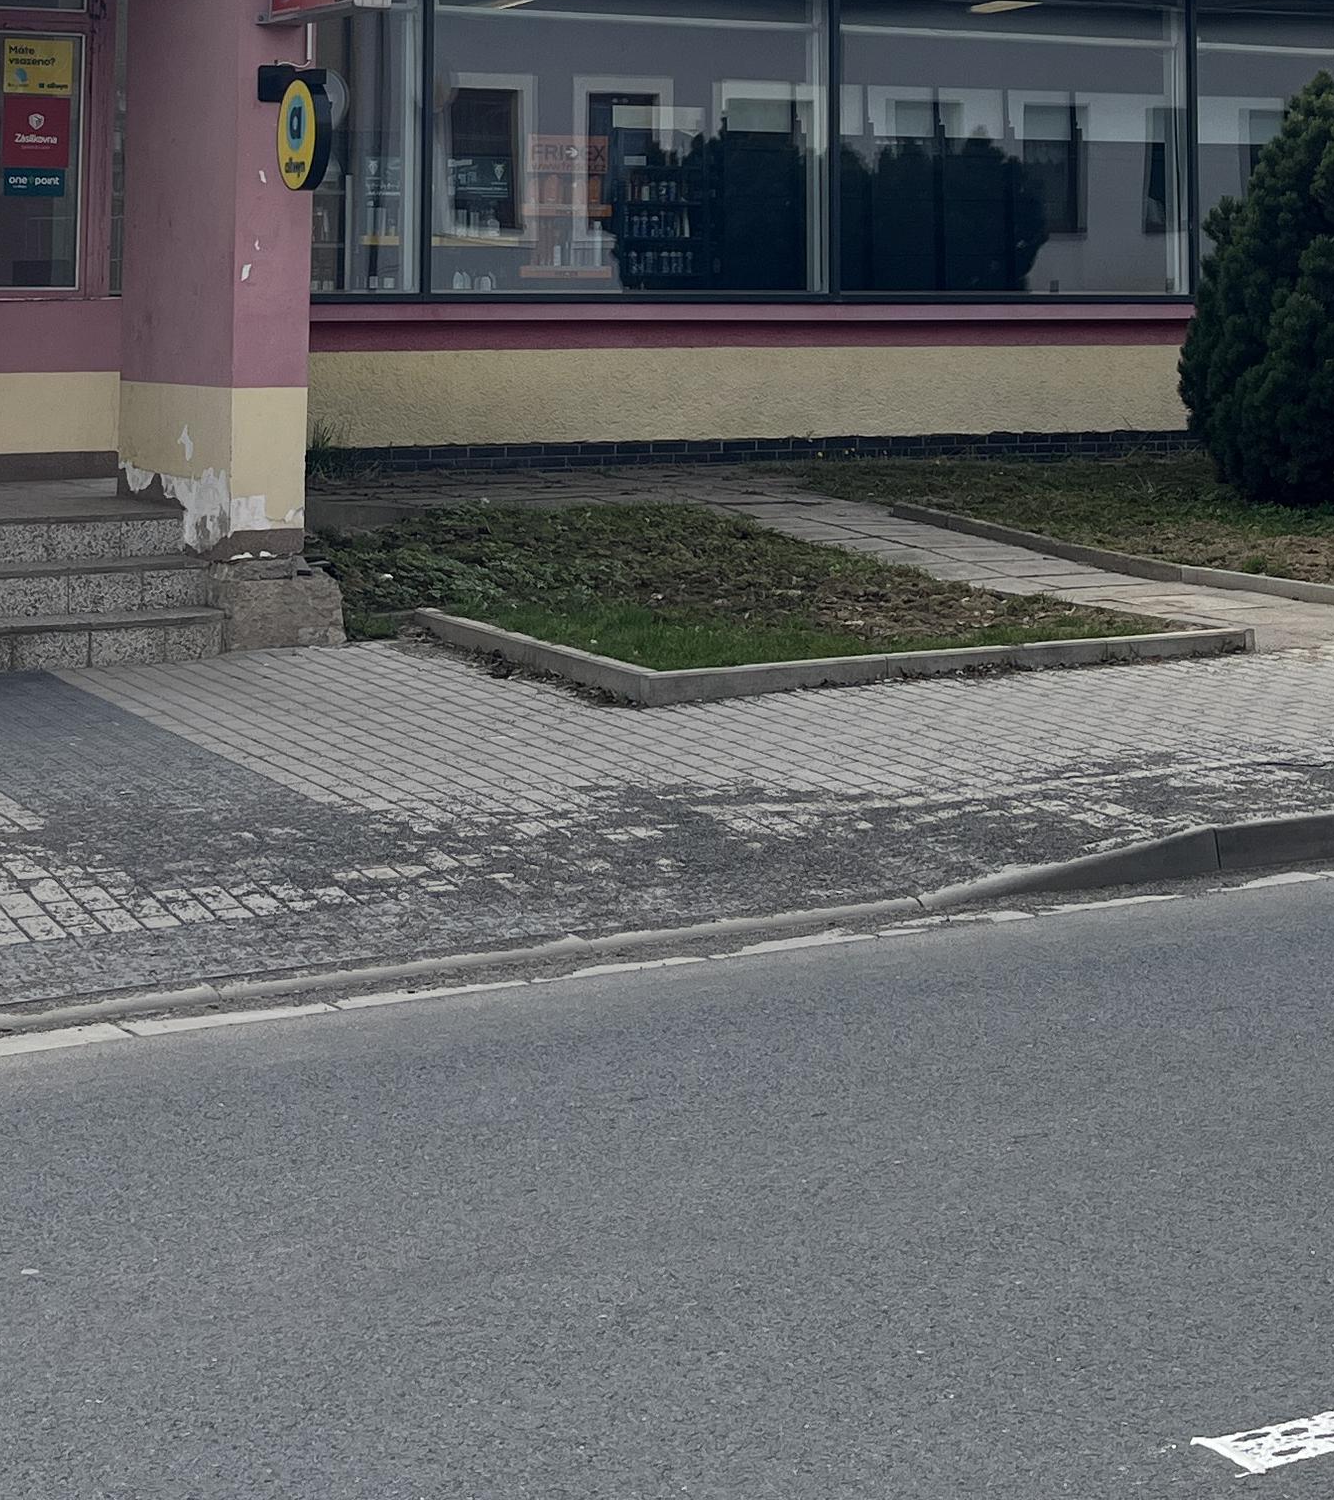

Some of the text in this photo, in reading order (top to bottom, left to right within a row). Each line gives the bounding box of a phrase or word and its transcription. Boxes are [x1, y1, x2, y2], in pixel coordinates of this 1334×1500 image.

[9, 44, 35, 55] Máte
[9, 56, 56, 67] vsazeno?
[14, 133, 58, 145] Zásilkovna
[8, 175, 60, 186] one point
